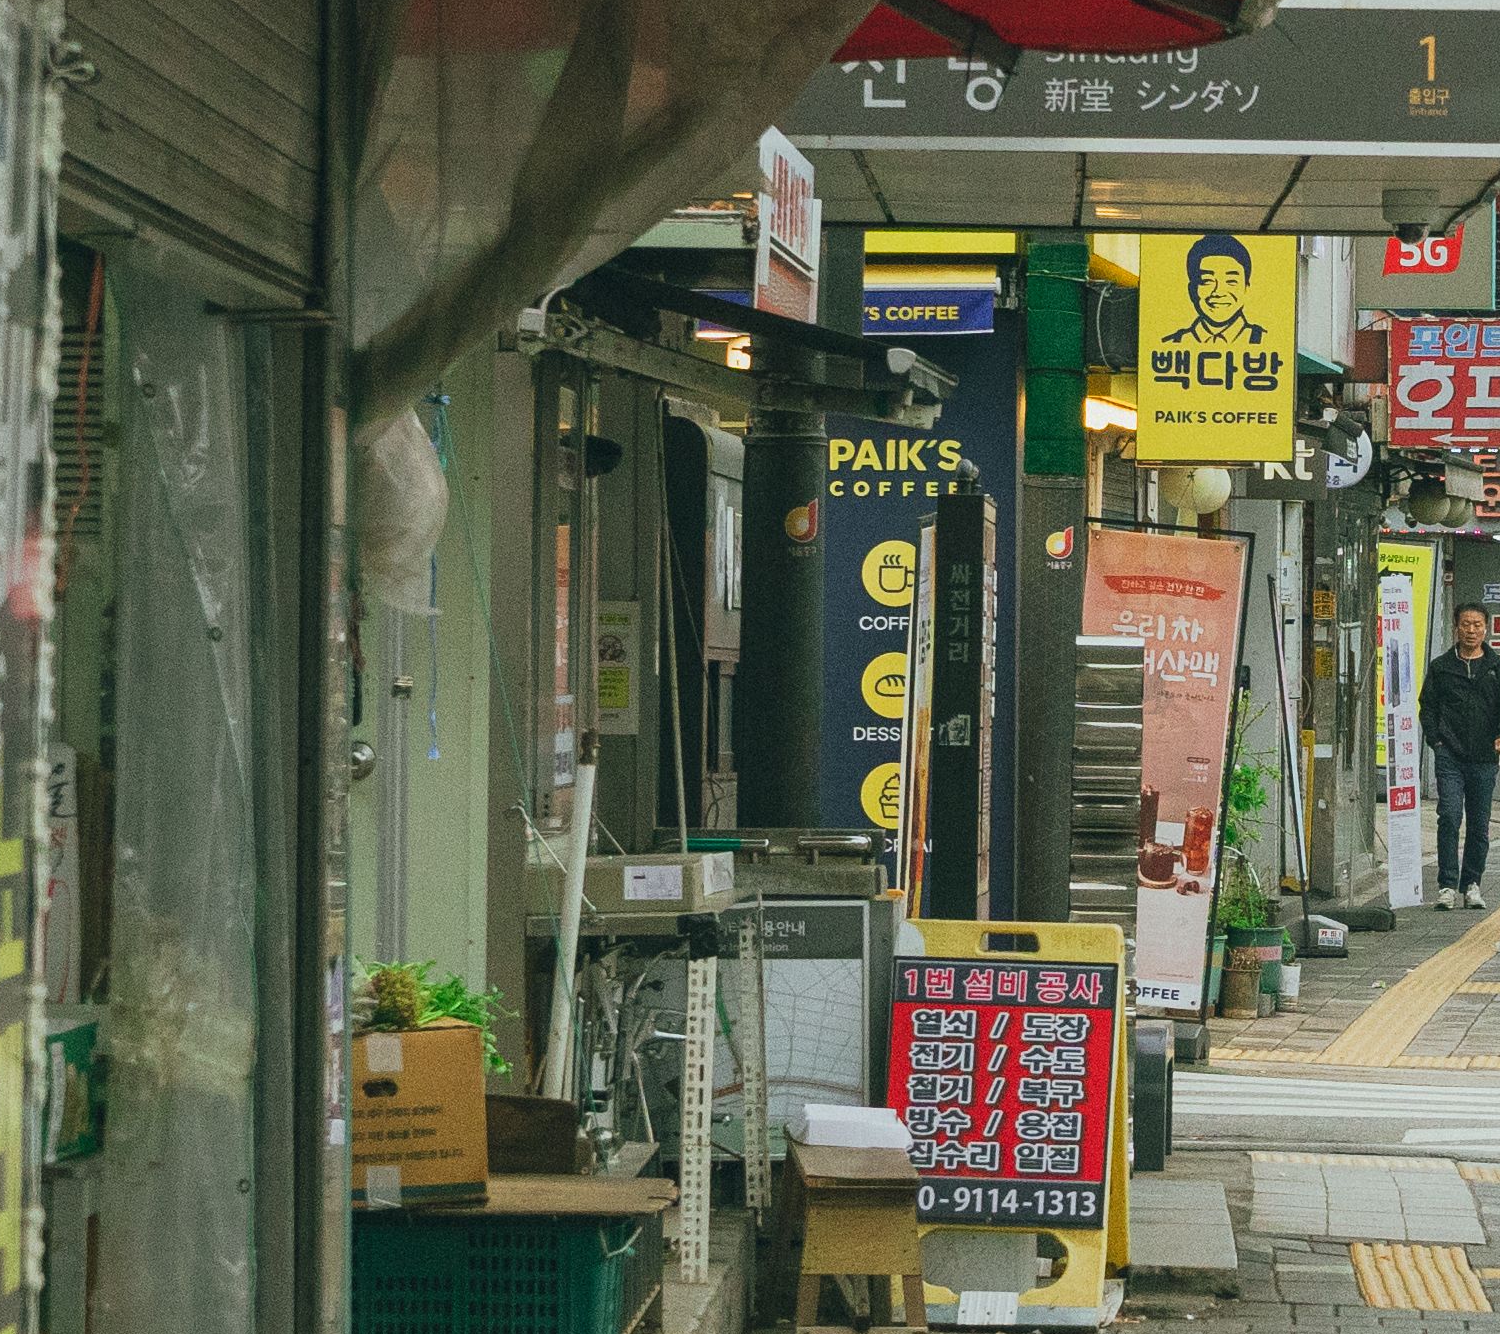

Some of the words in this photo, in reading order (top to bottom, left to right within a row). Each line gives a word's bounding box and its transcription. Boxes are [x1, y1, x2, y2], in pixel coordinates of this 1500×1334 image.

[1418, 34, 1437, 82] 1
[1044, 77, 1114, 113] 新堂
[1408, 86, 1451, 105] 출입구
[1399, 234, 1449, 268] 5G
[885, 305, 960, 322] COFFEE
[1151, 349, 1283, 394] 빽다방
[1211, 409, 1278, 425] COFFEE
[904, 967, 955, 998] 1번
[964, 969, 1028, 1002] 설비
[1036, 972, 1104, 1004] 공사
[911, 1008, 976, 1039] 열쇠
[1021, 1012, 1090, 1043] 도장
[909, 1042, 974, 1072] 전기
[1019, 1044, 1086, 1076] 수도
[906, 1074, 973, 1105] 철거
[1018, 1078, 1085, 1109] 복구
[905, 1107, 971, 1136] 방수
[1015, 1110, 1083, 1142] 용접
[906, 1140, 1000, 1171] 집수리
[1013, 1143, 1080, 1174] 일절
